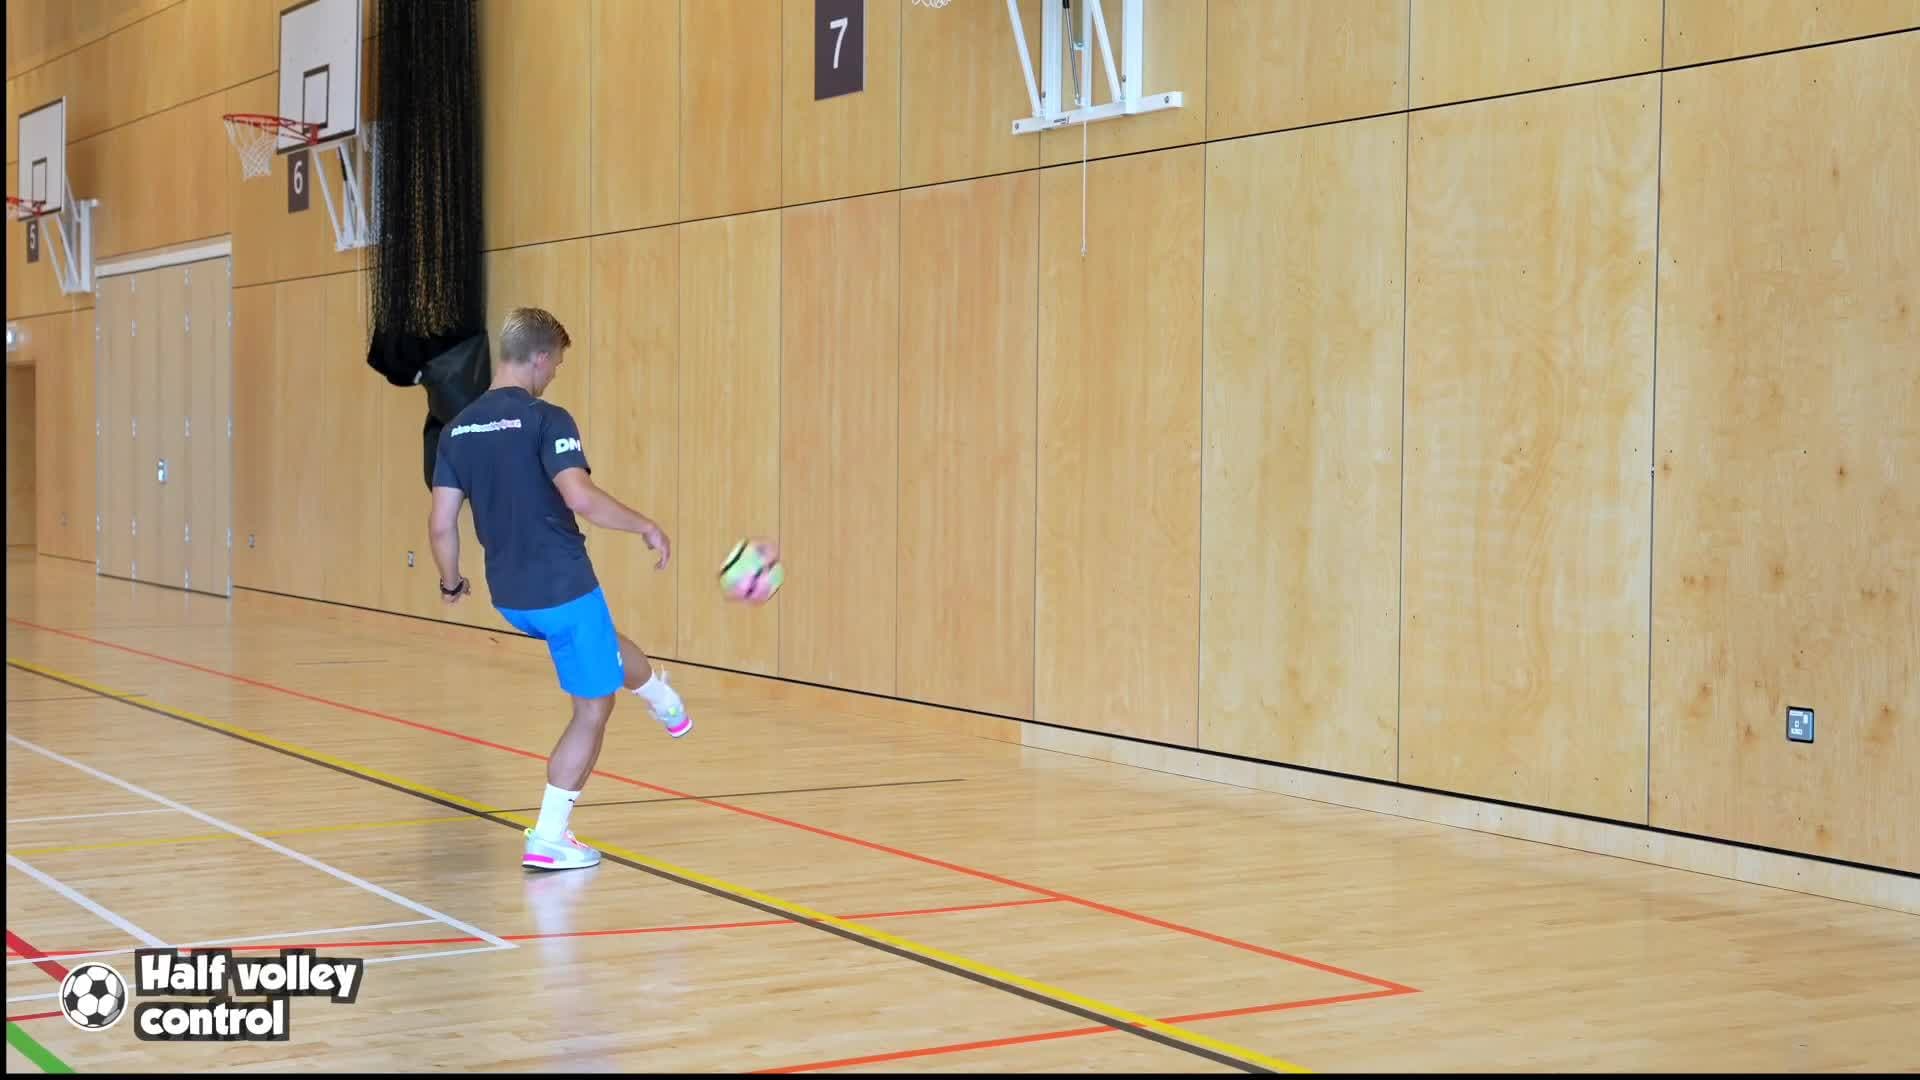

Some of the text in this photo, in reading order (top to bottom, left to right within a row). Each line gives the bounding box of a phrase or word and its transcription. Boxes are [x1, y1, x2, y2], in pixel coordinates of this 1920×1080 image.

[829, 17, 848, 69] 7
[293, 160, 304, 195] 6
[30, 223, 36, 249] 5
